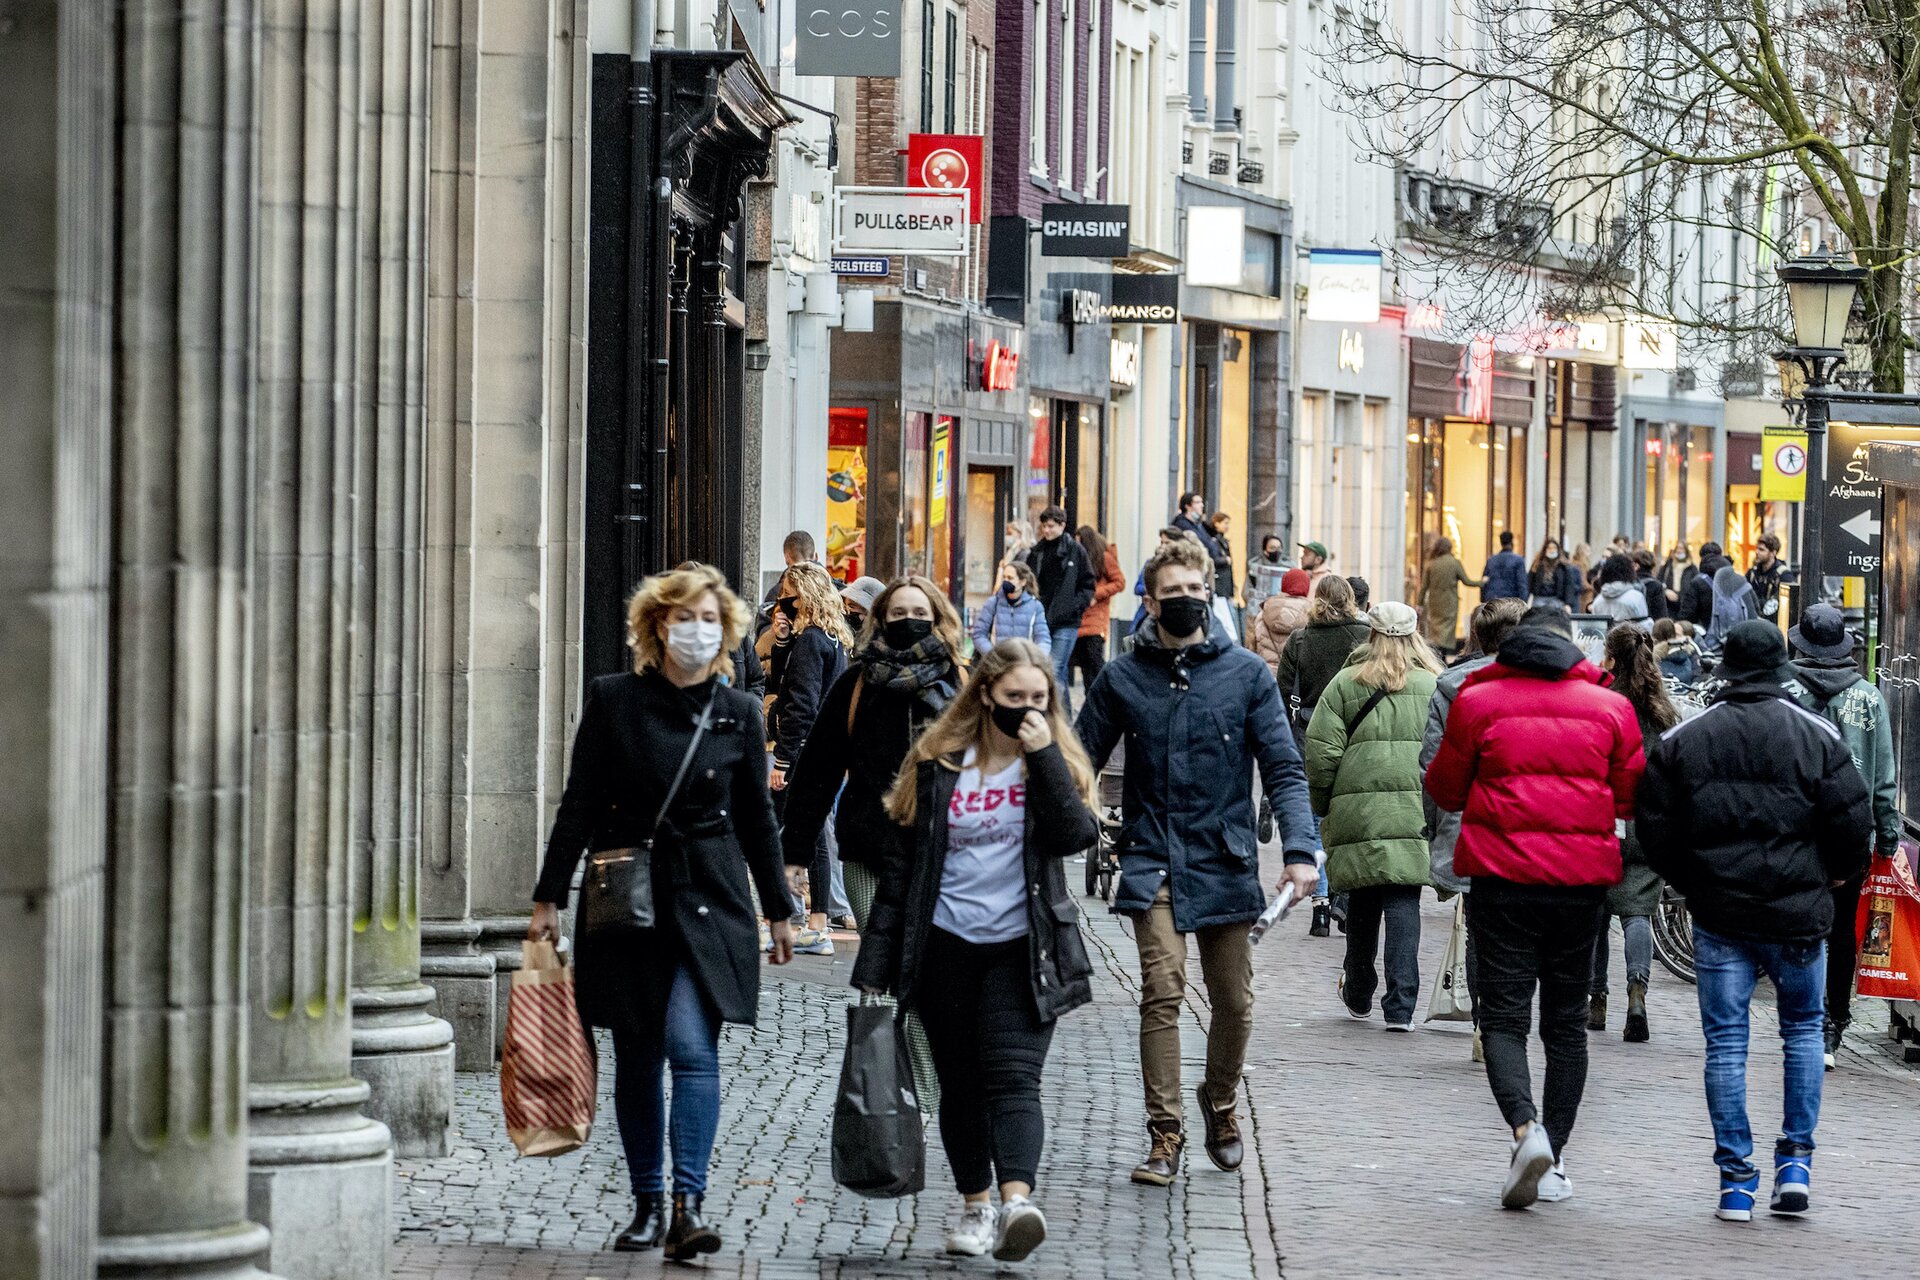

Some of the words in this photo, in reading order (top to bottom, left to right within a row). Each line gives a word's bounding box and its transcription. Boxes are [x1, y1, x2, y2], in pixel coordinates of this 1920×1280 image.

[807, 9, 891, 38] COS
[855, 212, 954, 231] PULL&BEAR
[1043, 220, 1128, 238] CHASIN'
[1111, 304, 1176, 320] MANGO
[1829, 485, 1876, 499] Afghaans
